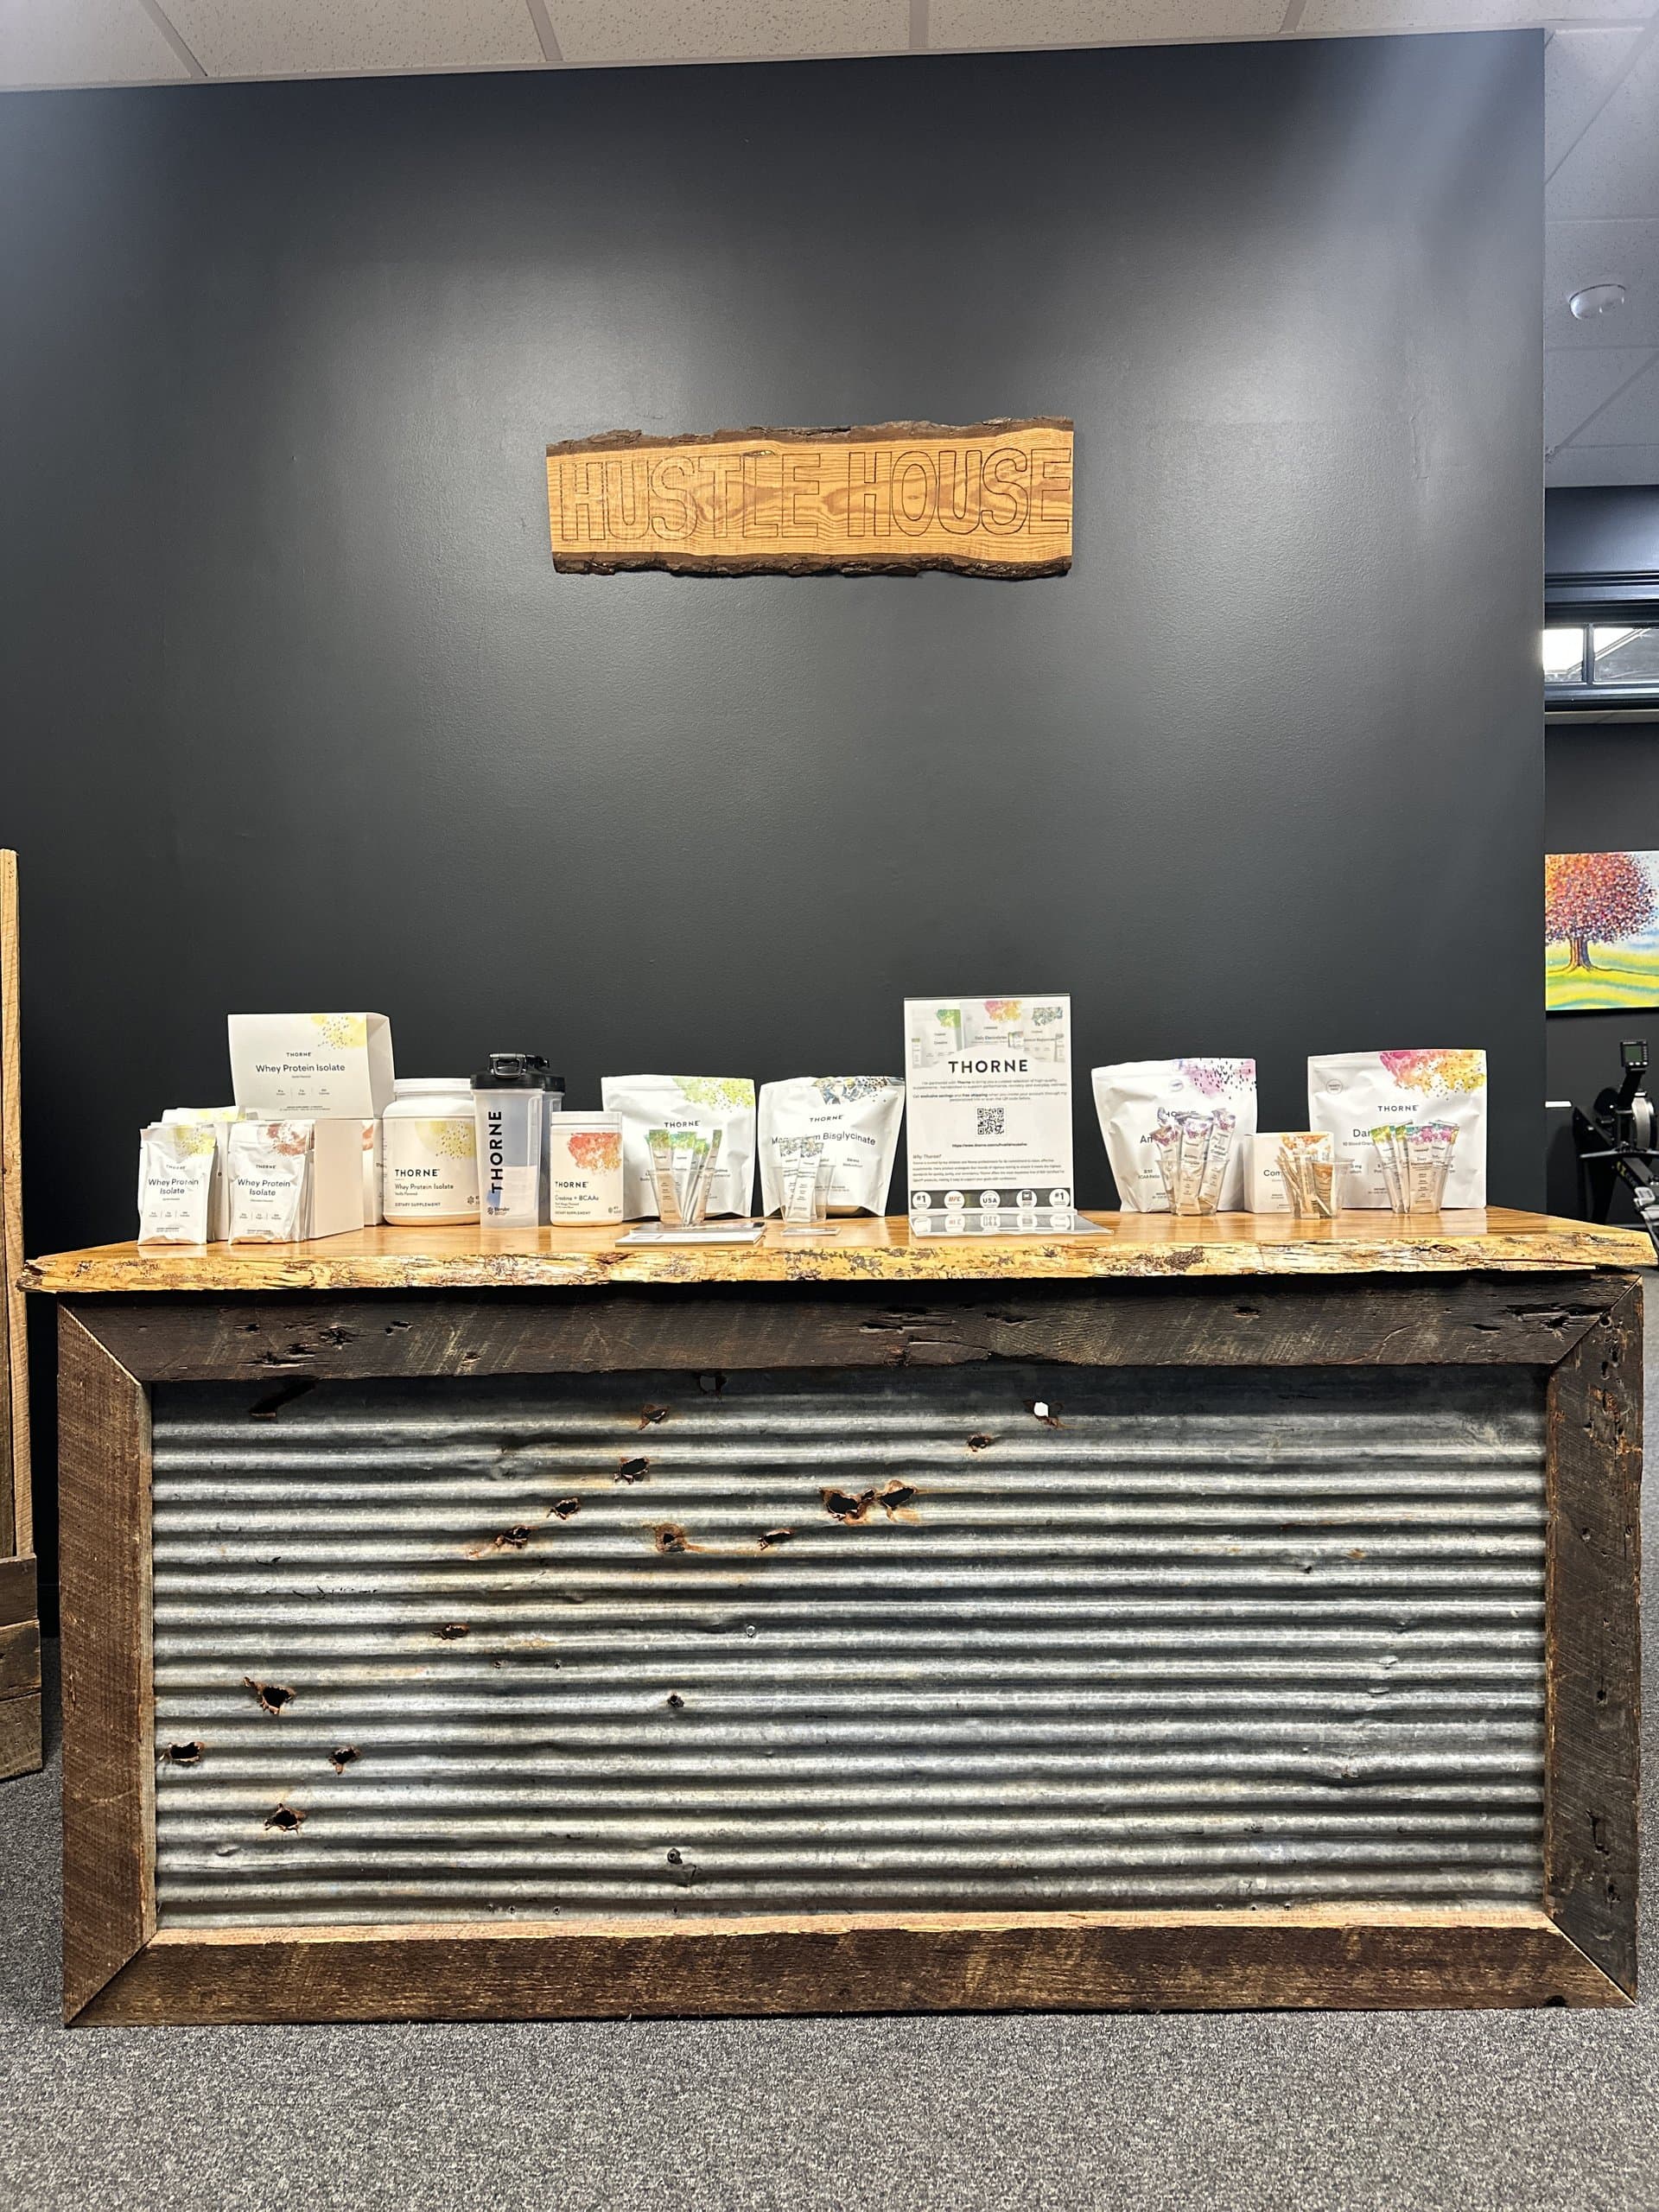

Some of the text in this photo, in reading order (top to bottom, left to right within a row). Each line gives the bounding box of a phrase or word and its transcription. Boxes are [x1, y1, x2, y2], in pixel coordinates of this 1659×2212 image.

[558, 448, 1071, 542] HUSTLE HOUSE
[256, 1063, 346, 1074] Whey Protein Isolate
[948, 1059, 1028, 1074] THORNE
[664, 1120, 699, 1128] THORNE
[823, 1130, 876, 1146] Bisglycinate
[488, 1110, 504, 1194] THORNE
[395, 1168, 439, 1177] THORNE
[149, 1179, 170, 1187] Whey
[238, 1179, 260, 1187] Whey
[395, 1183, 410, 1192] Whey
[917, 1195, 926, 1204] #1
[1054, 1192, 1065, 1200] #1
